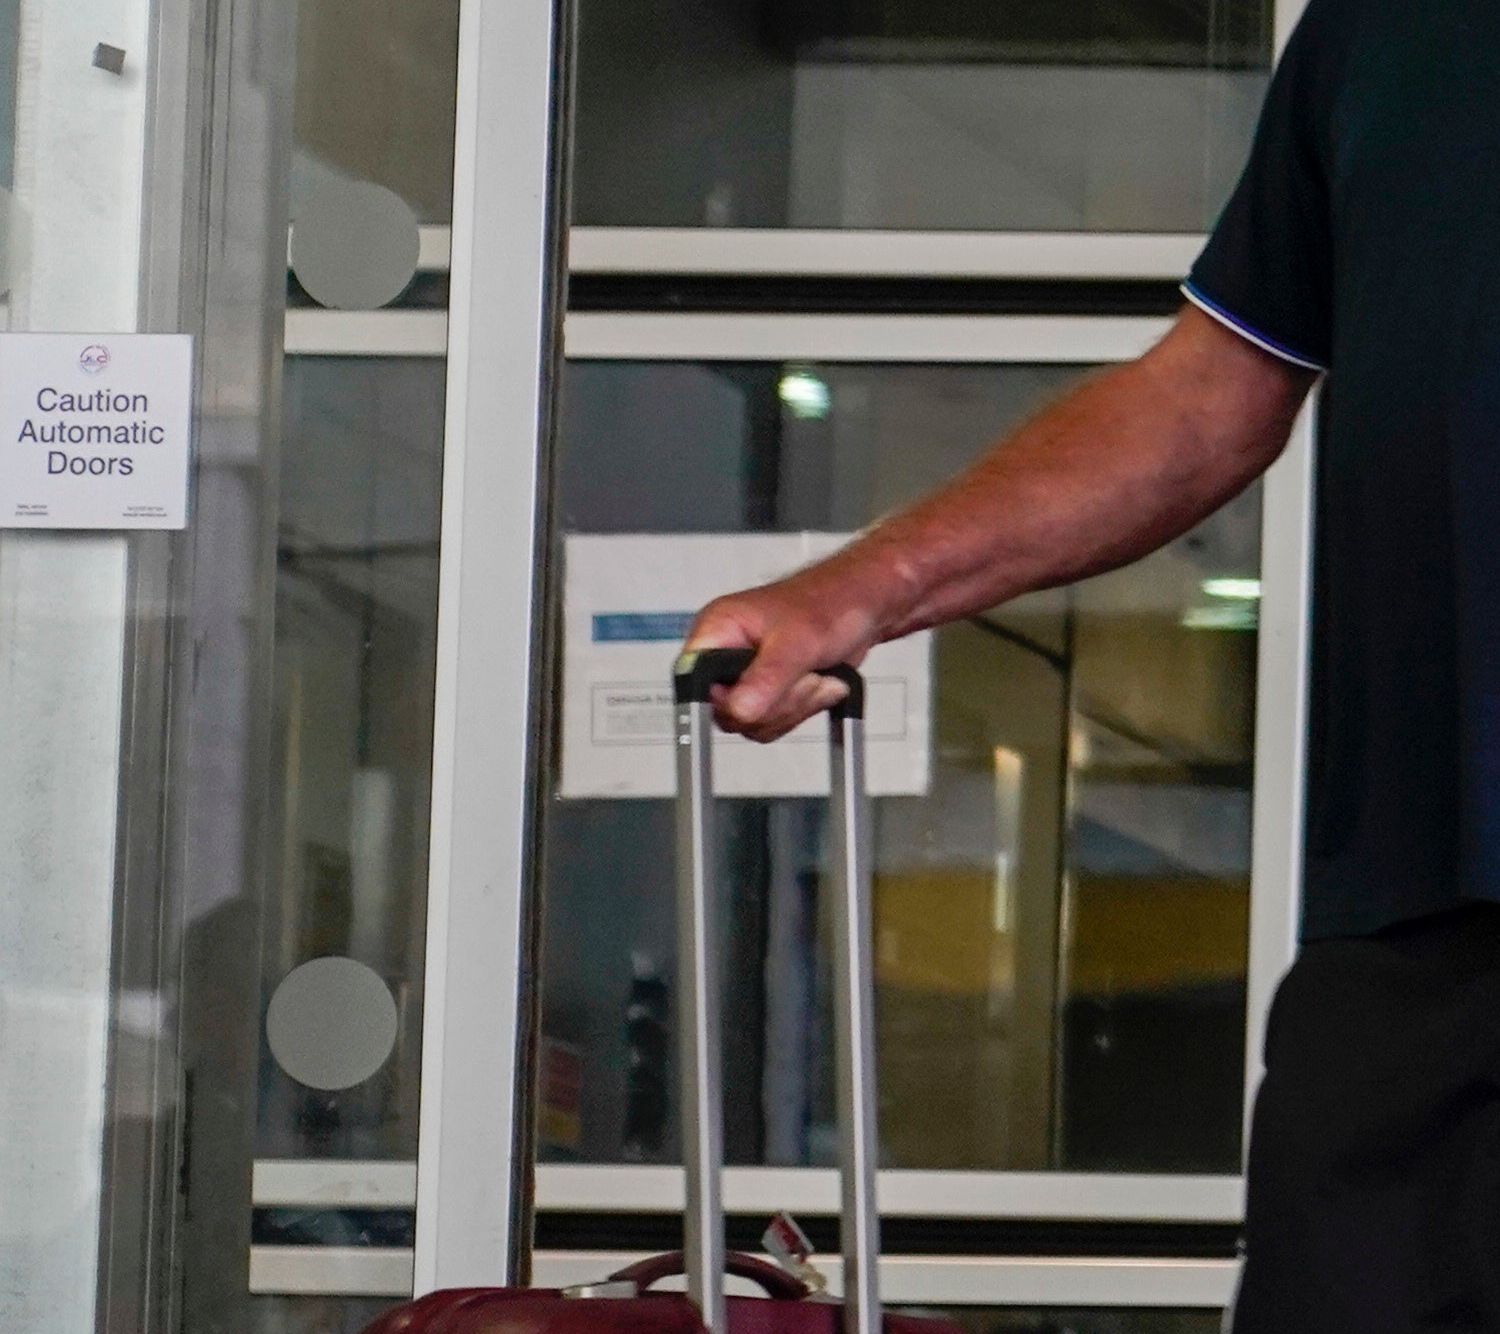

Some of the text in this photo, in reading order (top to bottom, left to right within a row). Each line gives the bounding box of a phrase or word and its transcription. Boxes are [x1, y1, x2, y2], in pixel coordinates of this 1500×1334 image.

[36, 387, 148, 412] Caution
[18, 419, 165, 445] Automatic
[47, 450, 134, 475] Doors
